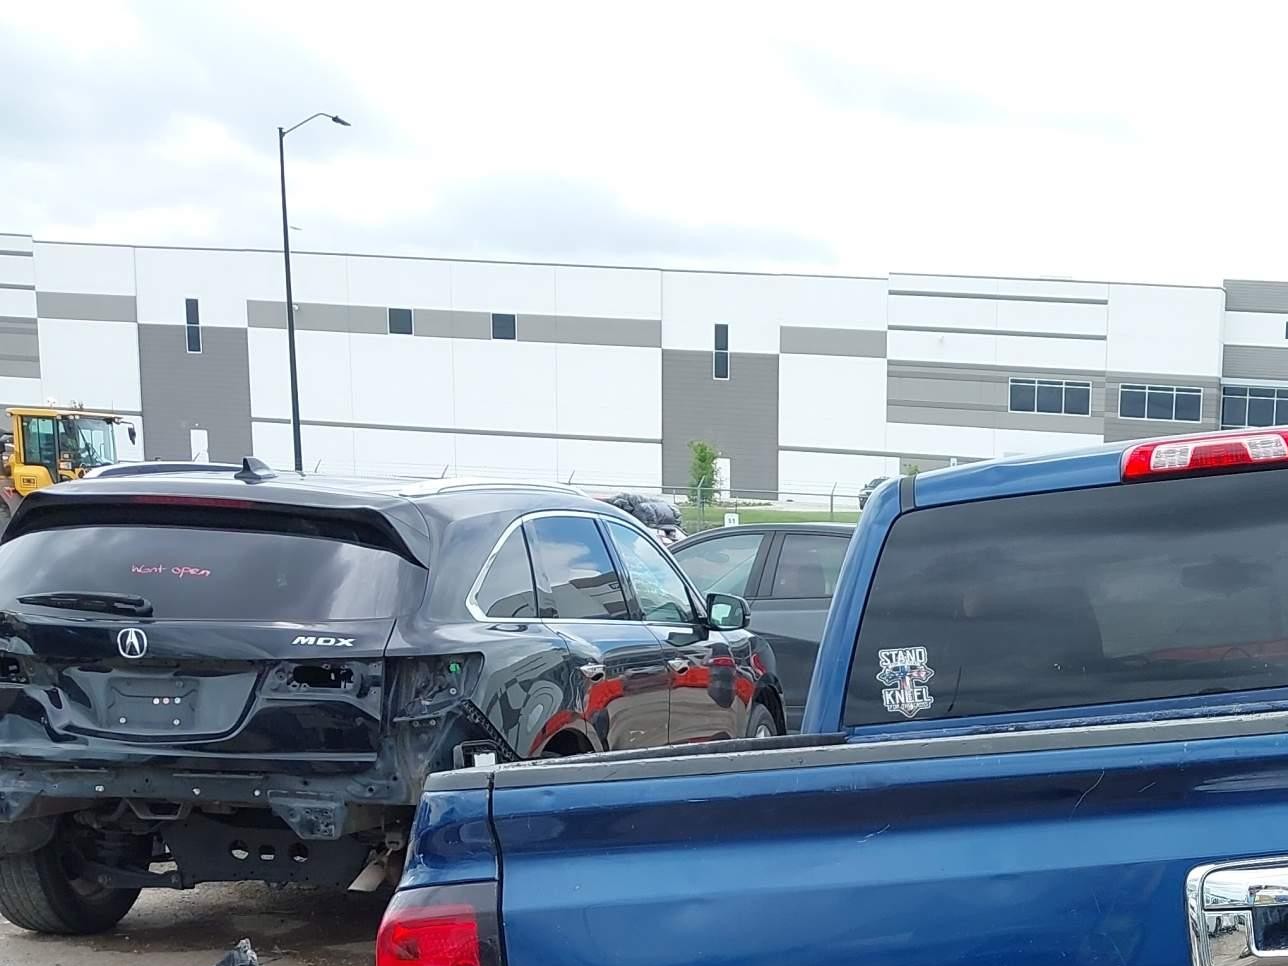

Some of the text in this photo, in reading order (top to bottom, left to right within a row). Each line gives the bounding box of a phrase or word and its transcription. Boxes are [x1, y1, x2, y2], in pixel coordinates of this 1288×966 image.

[292, 636, 355, 647] MDX
[881, 649, 925, 666] STAND
[885, 688, 931, 705] KNEEL
